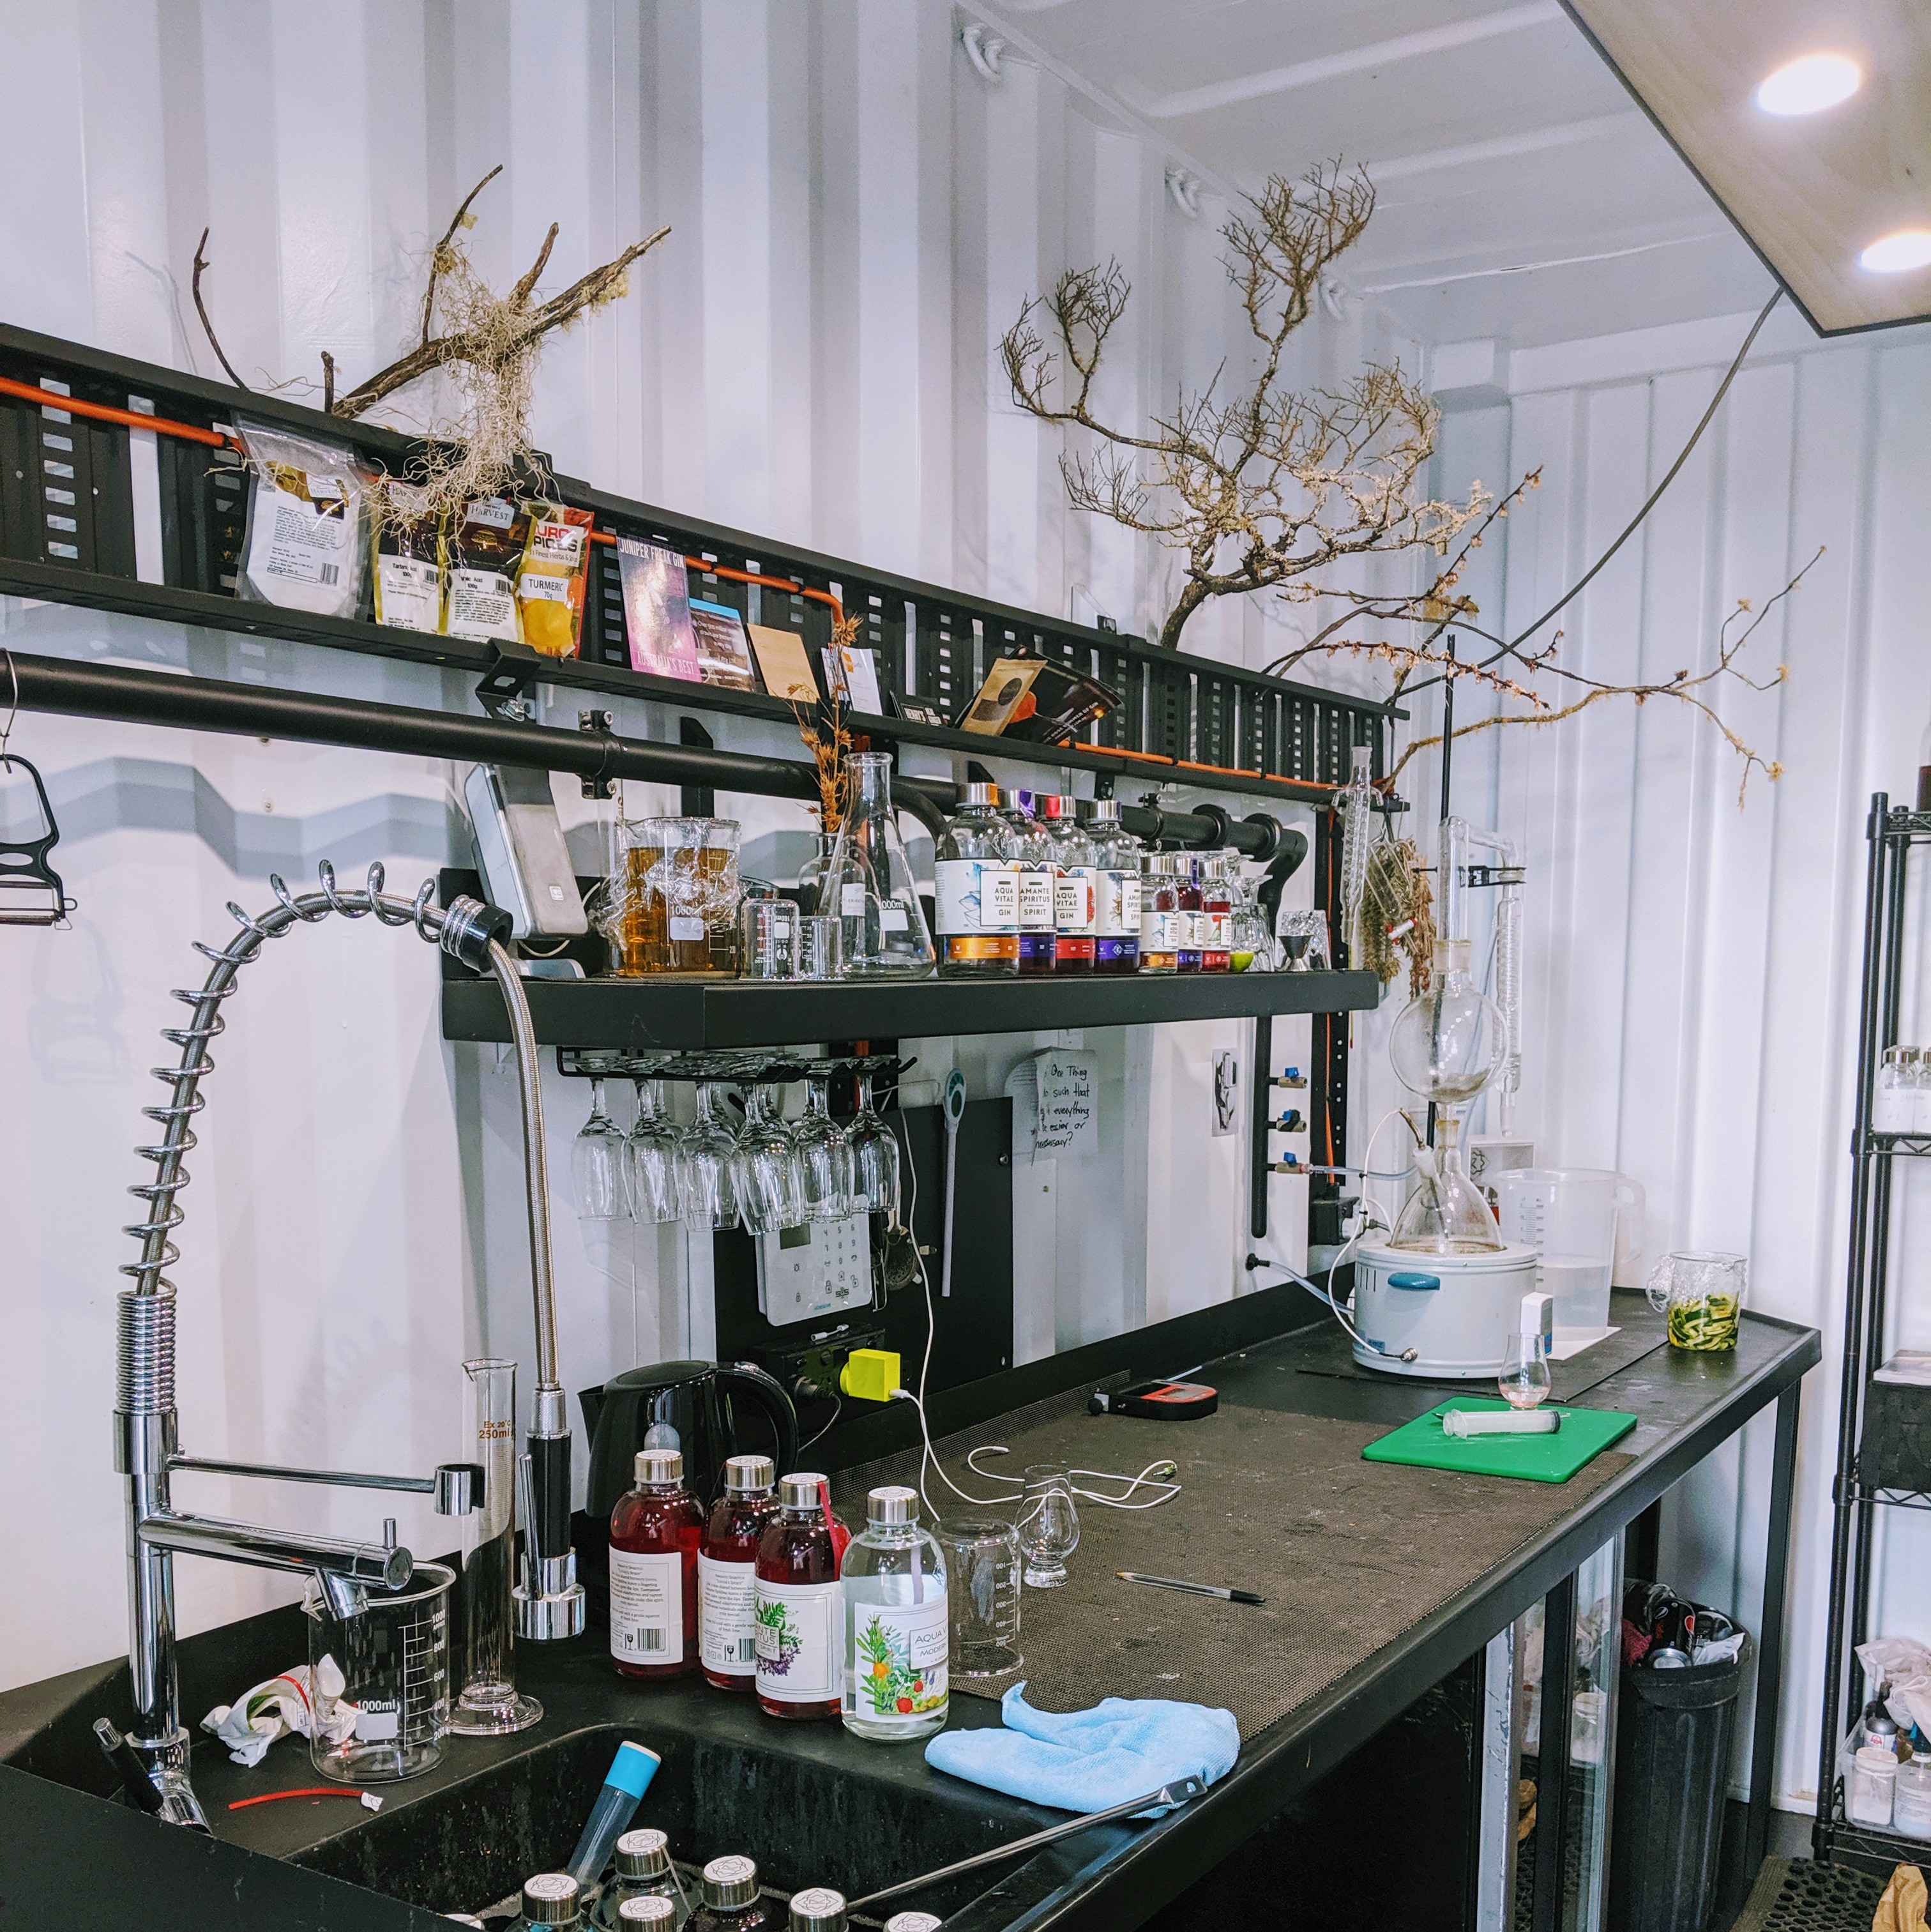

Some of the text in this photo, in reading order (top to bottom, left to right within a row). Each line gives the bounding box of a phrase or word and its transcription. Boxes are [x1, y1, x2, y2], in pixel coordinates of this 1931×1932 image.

[536, 525, 570, 538] URO
[620, 539, 649, 559] JUNIPER
[672, 553, 685, 568] GIN
[528, 579, 563, 591] TURMERIC
[678, 659, 695, 674] BEST
[881, 899, 905, 909] 000ml
[1066, 1065, 1087, 1081] Thing
[1054, 1083, 1090, 1097] such that
[1054, 1101, 1089, 1119] everything
[478, 1427, 510, 1439] 250ml
[432, 1609, 446, 1624] 1000
[915, 1630, 943, 1644] AQUA
[434, 1639, 444, 1653] 800
[434, 1668, 444, 1682] 600
[356, 1698, 395, 1712] 1000ml
[434, 1698, 444, 1711] 400
[434, 1727, 444, 1741] 200
